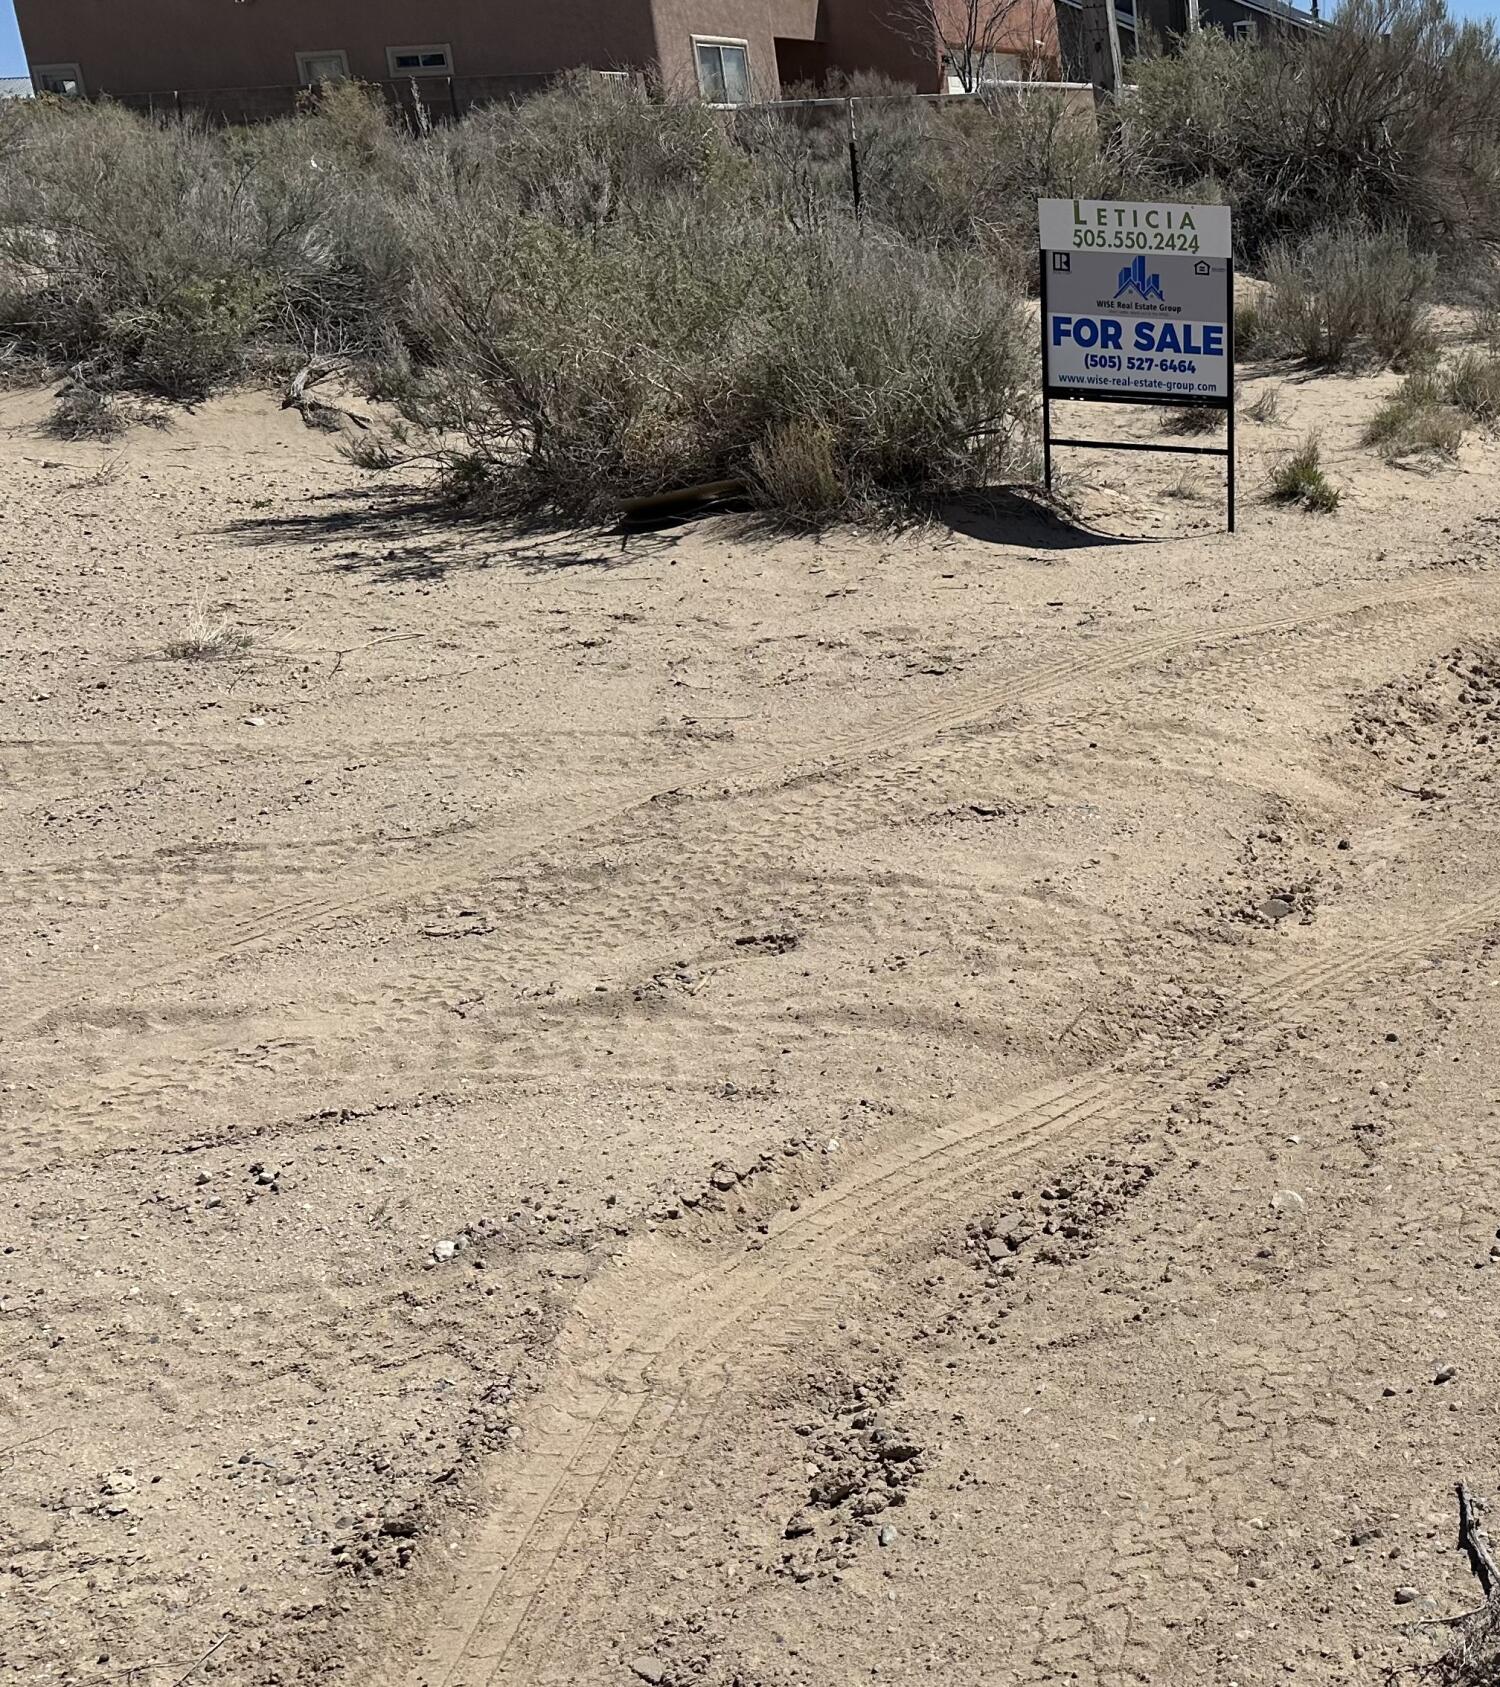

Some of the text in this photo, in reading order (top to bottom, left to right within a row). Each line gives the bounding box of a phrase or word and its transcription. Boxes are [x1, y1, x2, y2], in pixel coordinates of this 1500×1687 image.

[1073, 200, 1196, 230] LETICIA
[1072, 229, 1200, 254] 505.550.2424
[1096, 300, 1182, 313] WISE Real Estate Group
[1052, 316, 1224, 356] FOR SALE
[1084, 353, 1196, 374] (505) 527-6464
[1058, 372, 1217, 392] www.wise-real-estate-group.com
